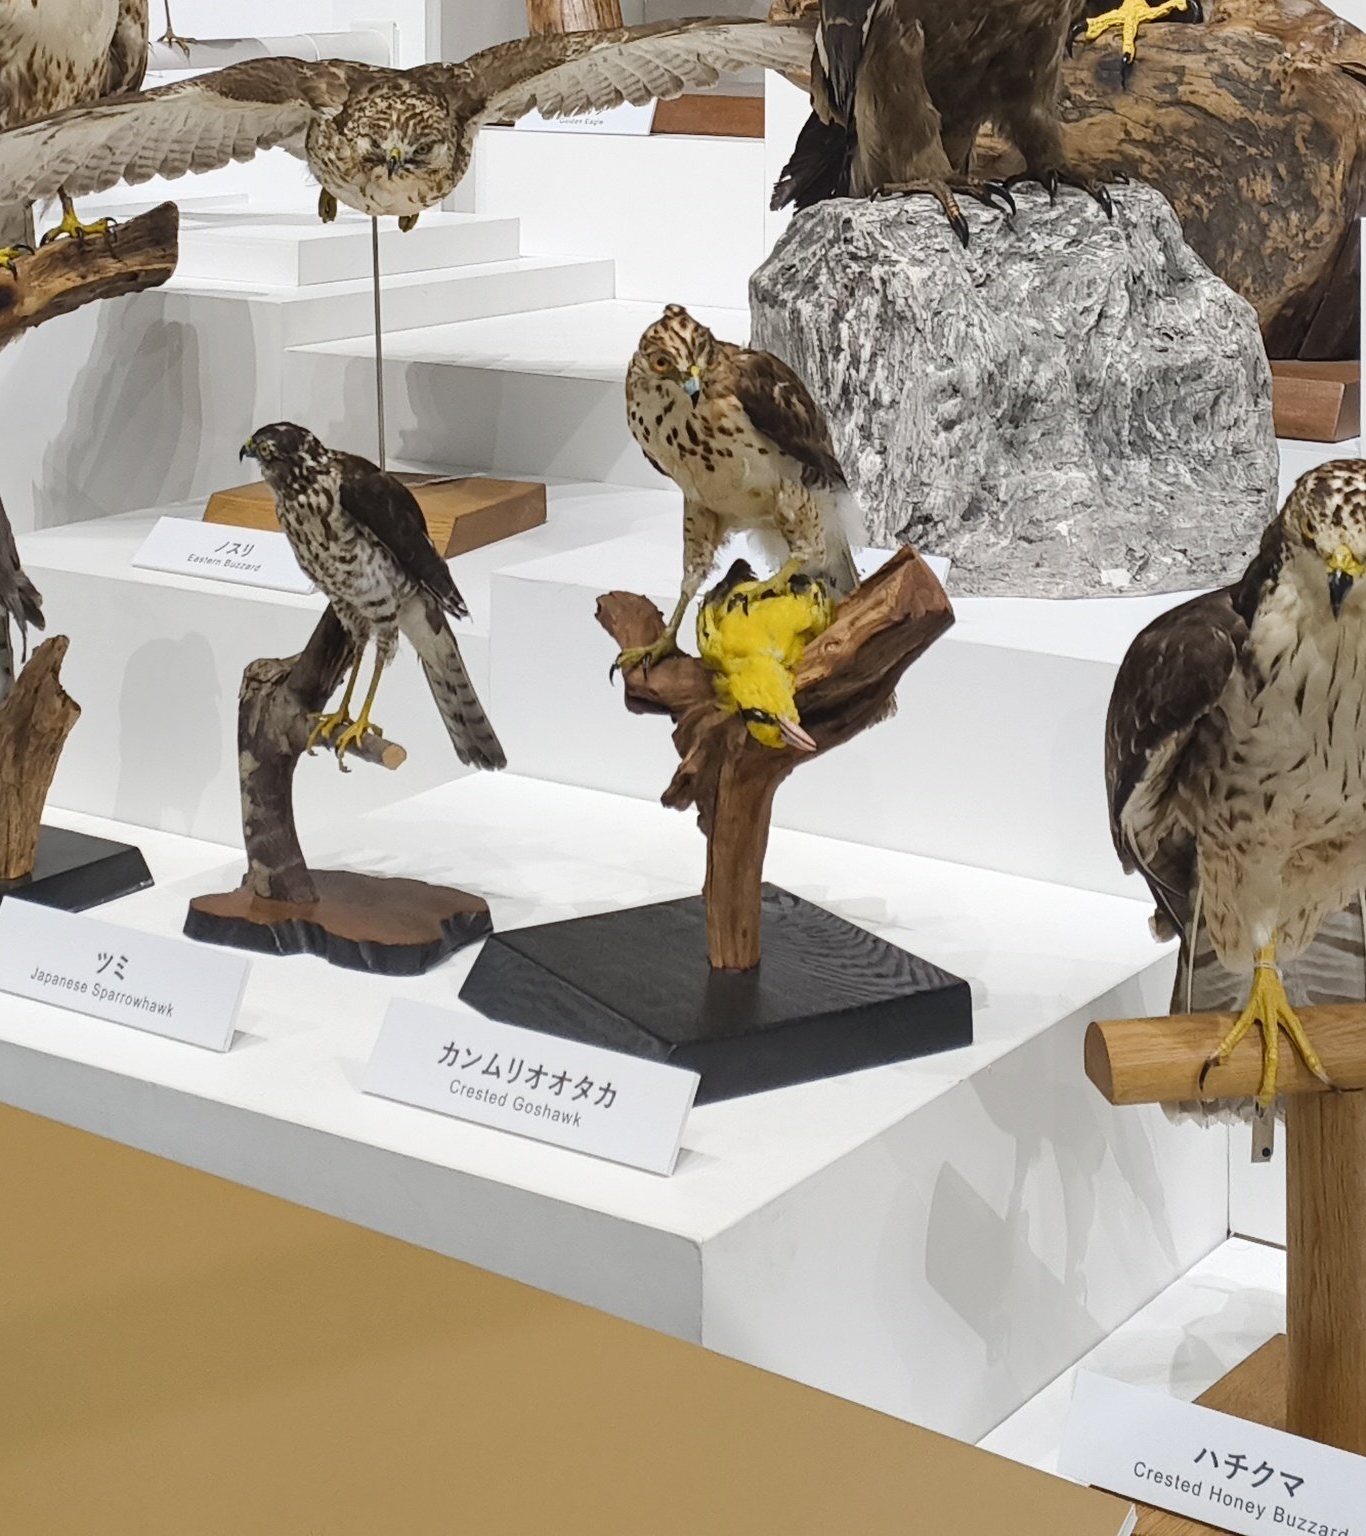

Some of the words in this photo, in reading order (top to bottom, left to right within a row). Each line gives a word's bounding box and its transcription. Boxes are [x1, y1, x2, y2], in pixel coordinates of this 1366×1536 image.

[187, 553, 221, 566] Eastern
[223, 559, 261, 572] Buzzard
[215, 541, 255, 558] ノスリ
[97, 952, 128, 980] ツミ
[30, 966, 88, 993] Japanese
[91, 983, 174, 1017] Sparrowhawk
[437, 1040, 618, 1109] カンムリオオタカ
[449, 1079, 506, 1109] Crested
[513, 1095, 582, 1128] Goshawk
[1193, 1444, 1306, 1499] ハチクマ
[1133, 1461, 1202, 1497] Crested
[1209, 1483, 1267, 1523] Honey
[1272, 1504, 1350, 1536] Buzzard
